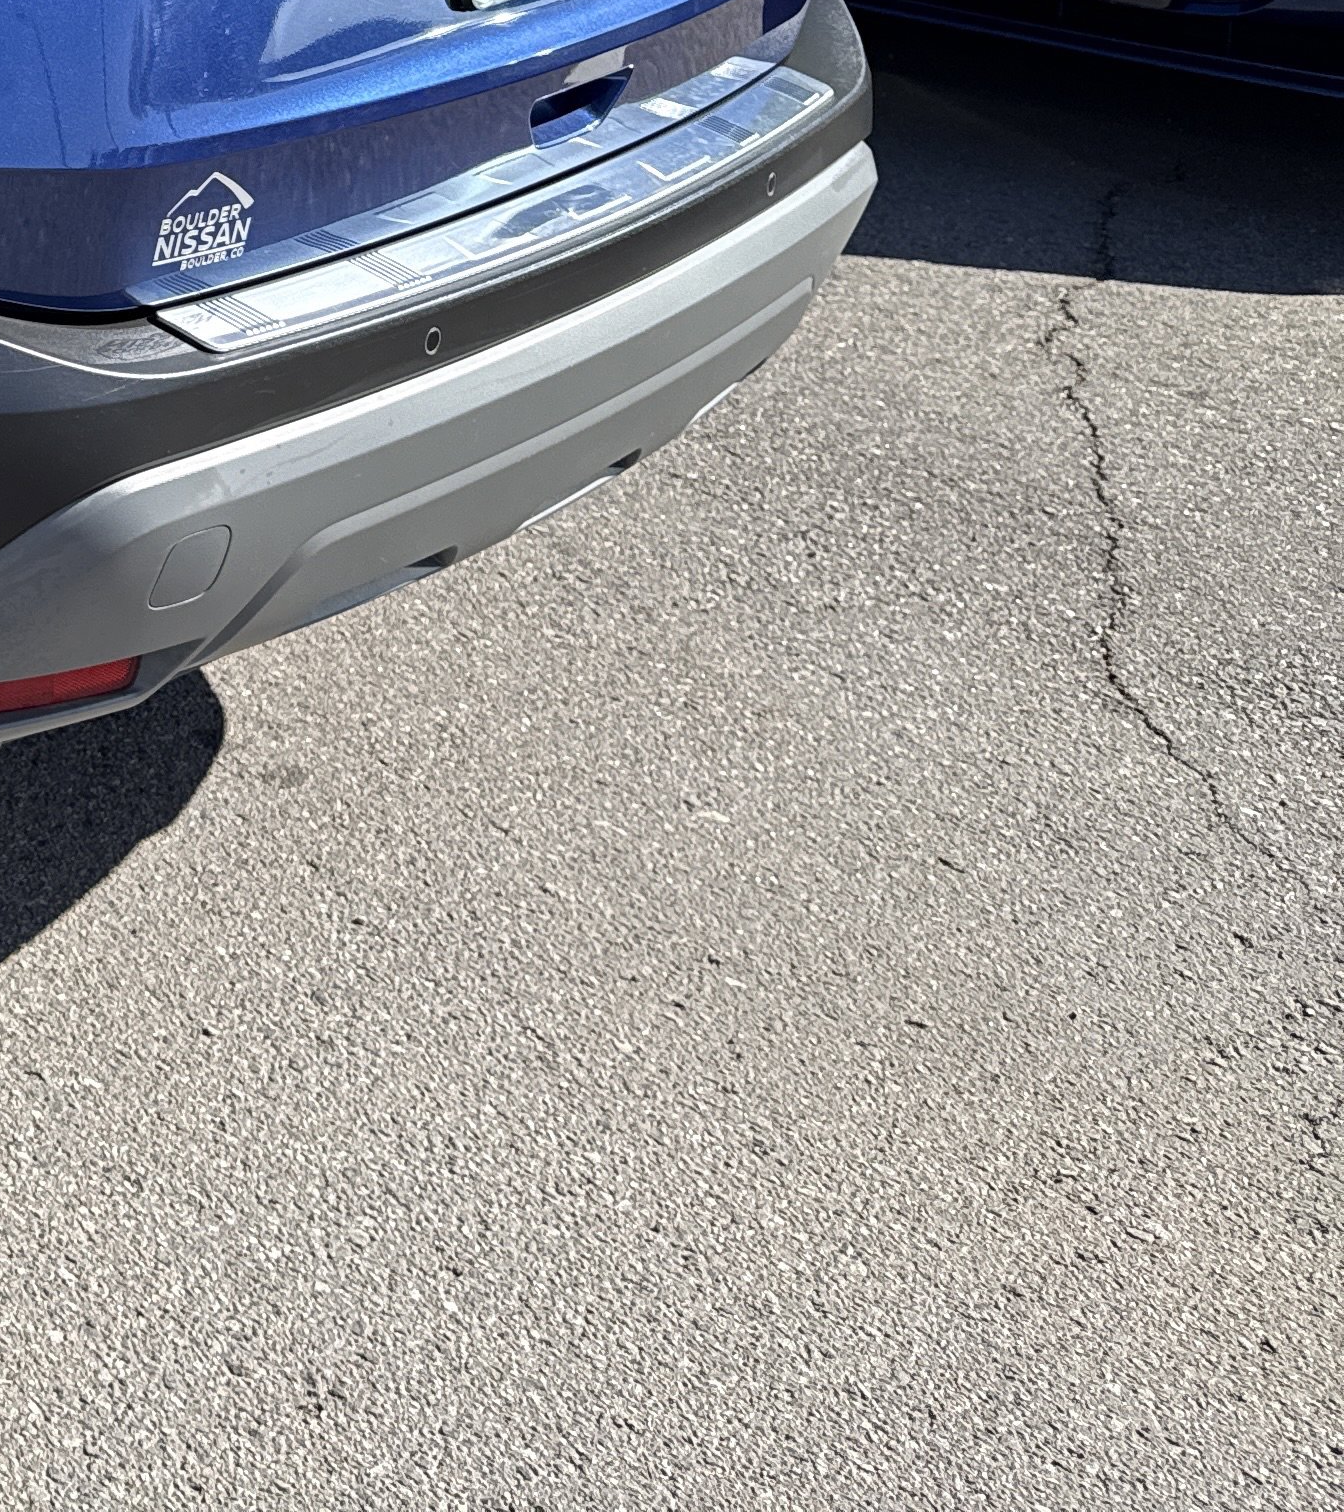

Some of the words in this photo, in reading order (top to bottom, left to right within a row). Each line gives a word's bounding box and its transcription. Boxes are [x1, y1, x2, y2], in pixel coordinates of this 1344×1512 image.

[159, 203, 242, 236] BOULDER
[153, 216, 252, 261] NISSAN
[230, 246, 244, 259] CO
